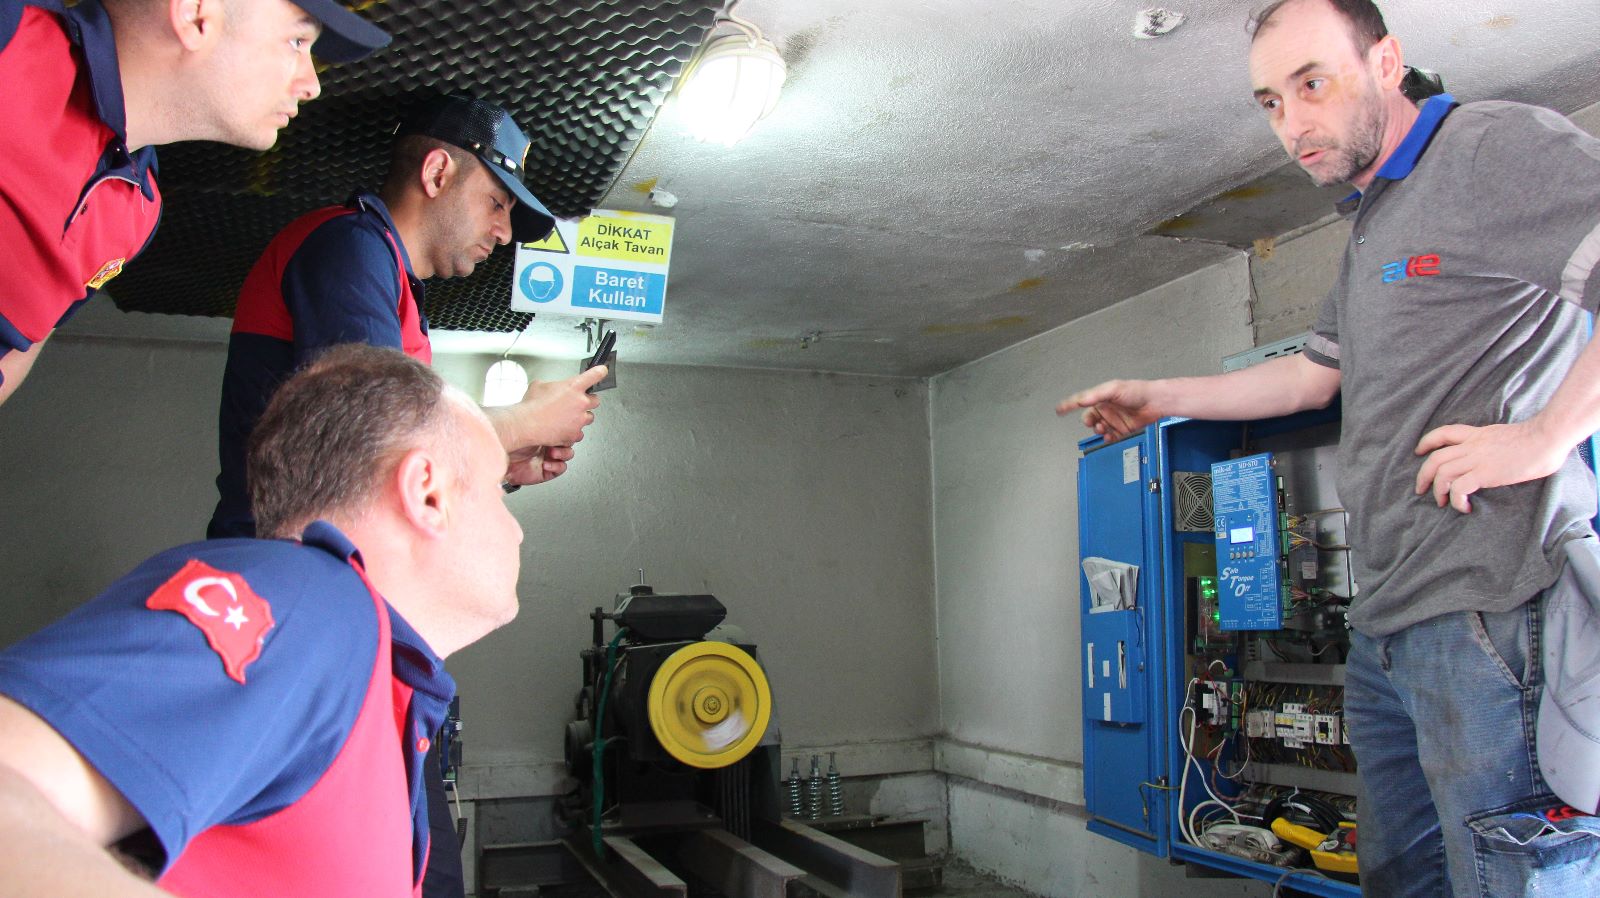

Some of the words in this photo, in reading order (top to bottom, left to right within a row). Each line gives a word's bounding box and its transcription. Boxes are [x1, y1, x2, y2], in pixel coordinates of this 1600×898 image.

[597, 224, 652, 240] DİKKAT
[580, 236, 619, 252] Alçak
[624, 241, 664, 255] Tavan
[595, 271, 645, 289] Baret
[588, 289, 646, 308] Kullan
